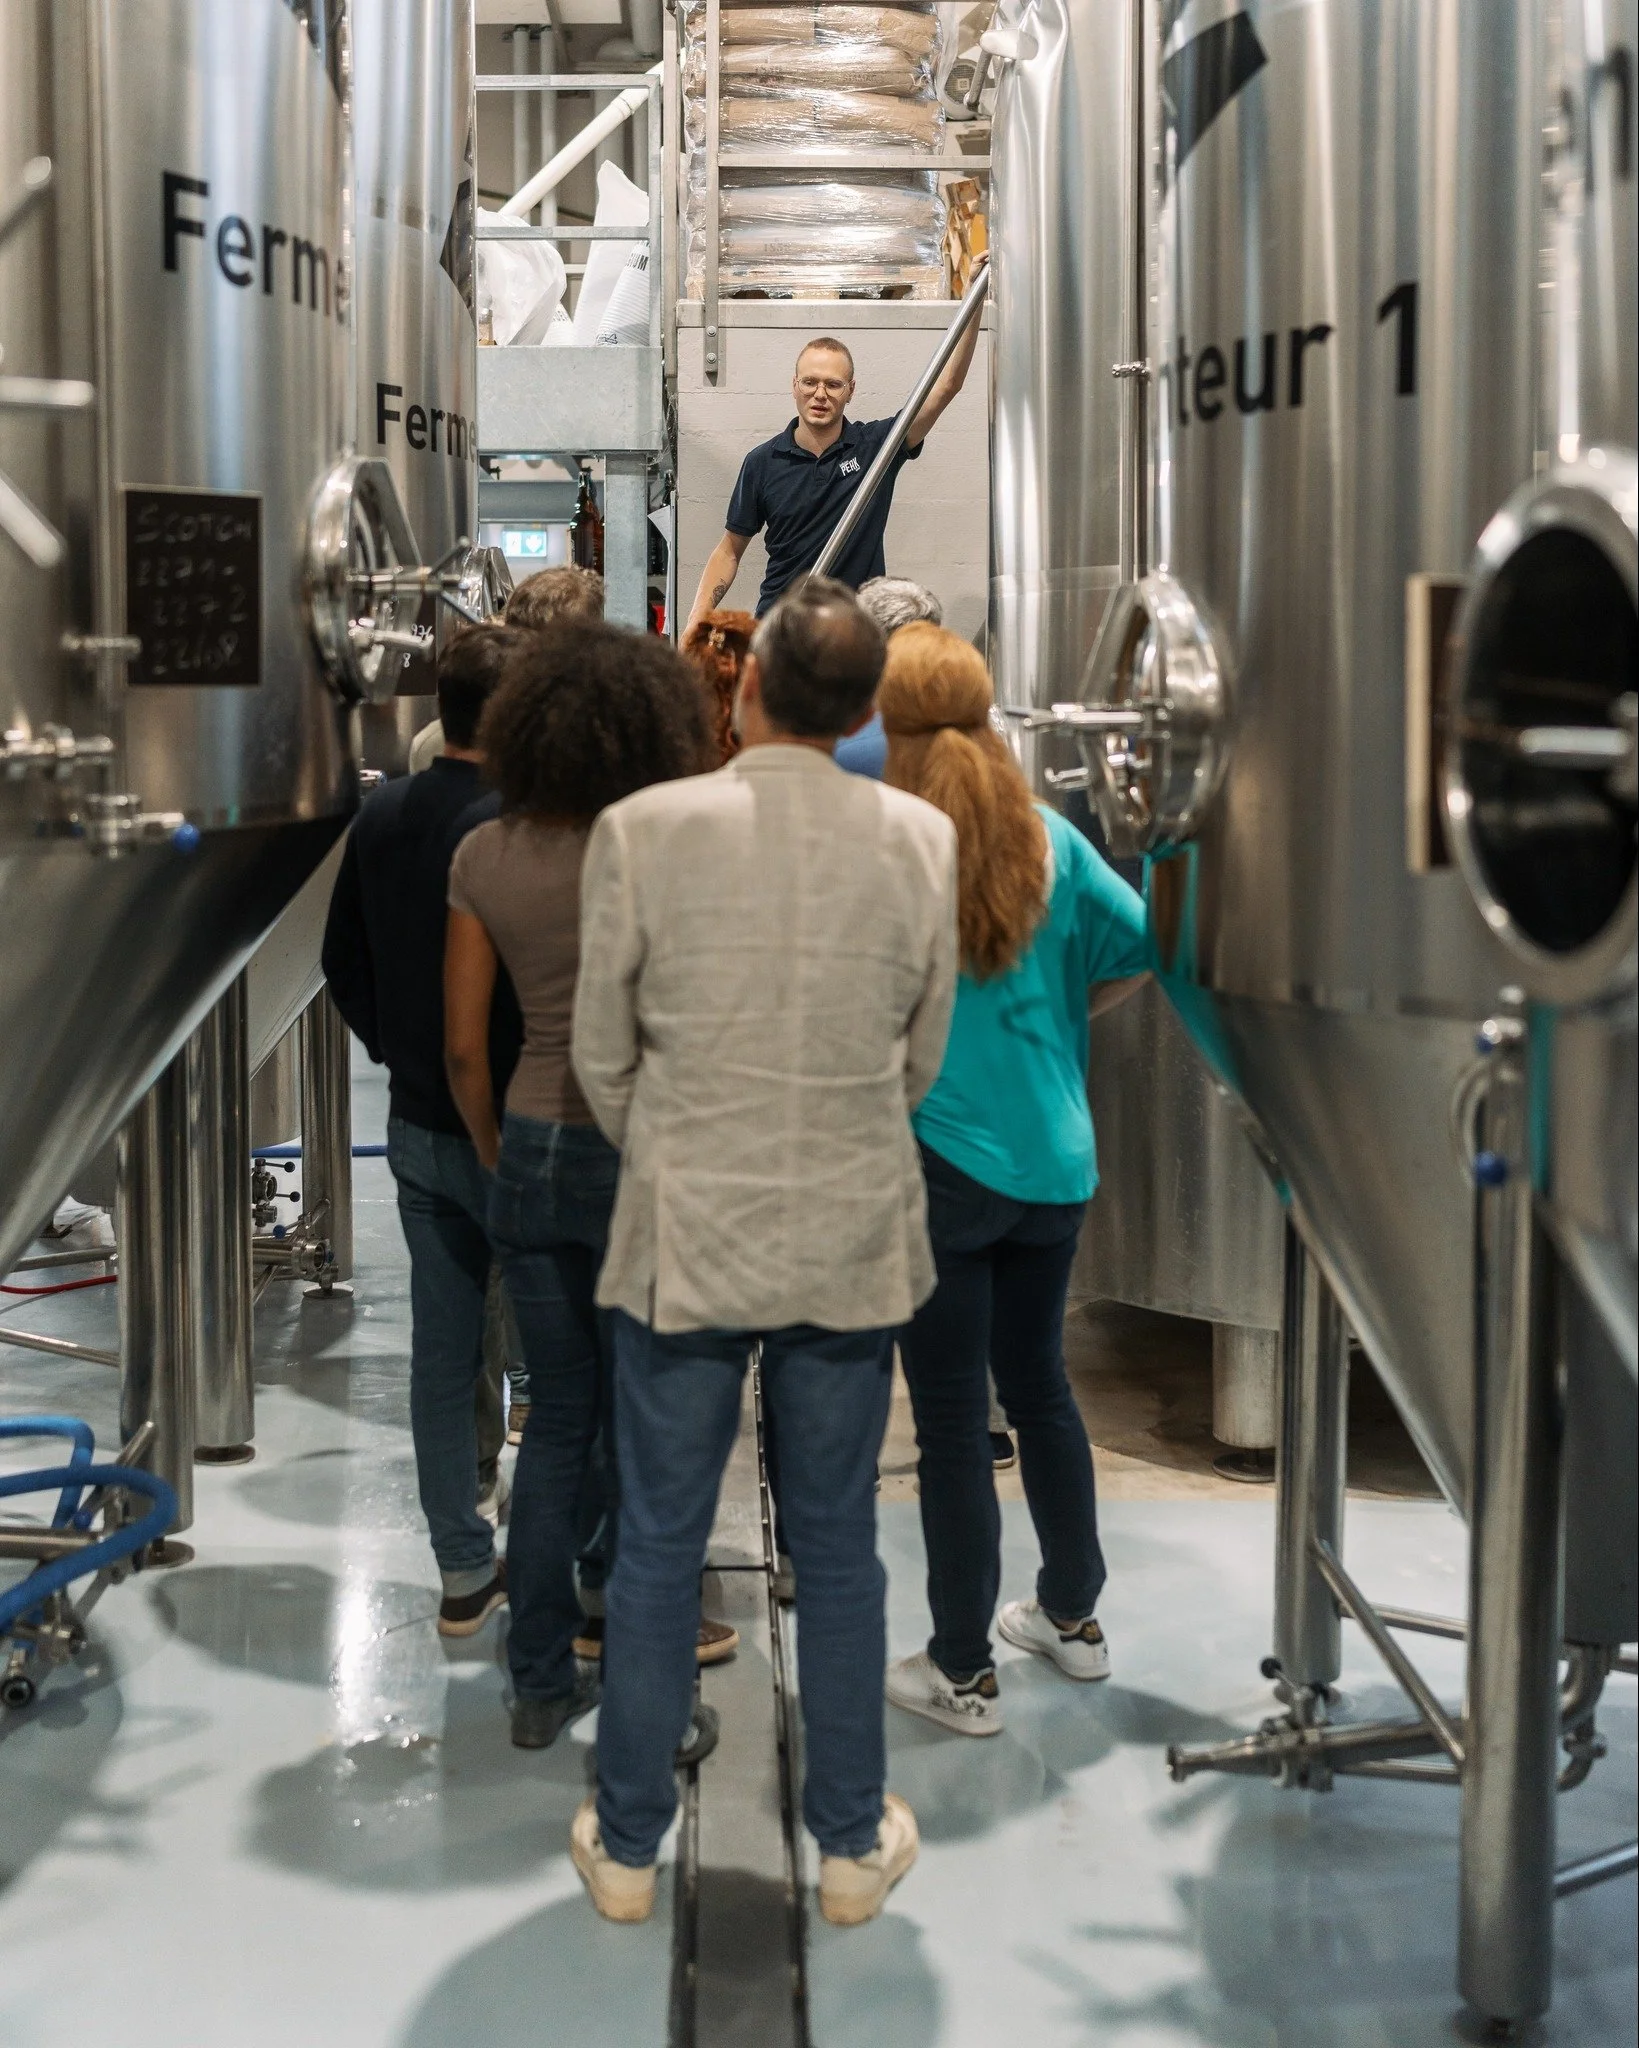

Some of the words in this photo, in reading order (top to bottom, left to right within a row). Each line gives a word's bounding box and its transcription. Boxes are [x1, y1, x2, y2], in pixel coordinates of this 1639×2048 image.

[1162, 322, 1332, 427] teur
[1377, 281, 1419, 395] 1
[376, 382, 477, 463] Ferme
[840, 456, 861, 477] PERK
